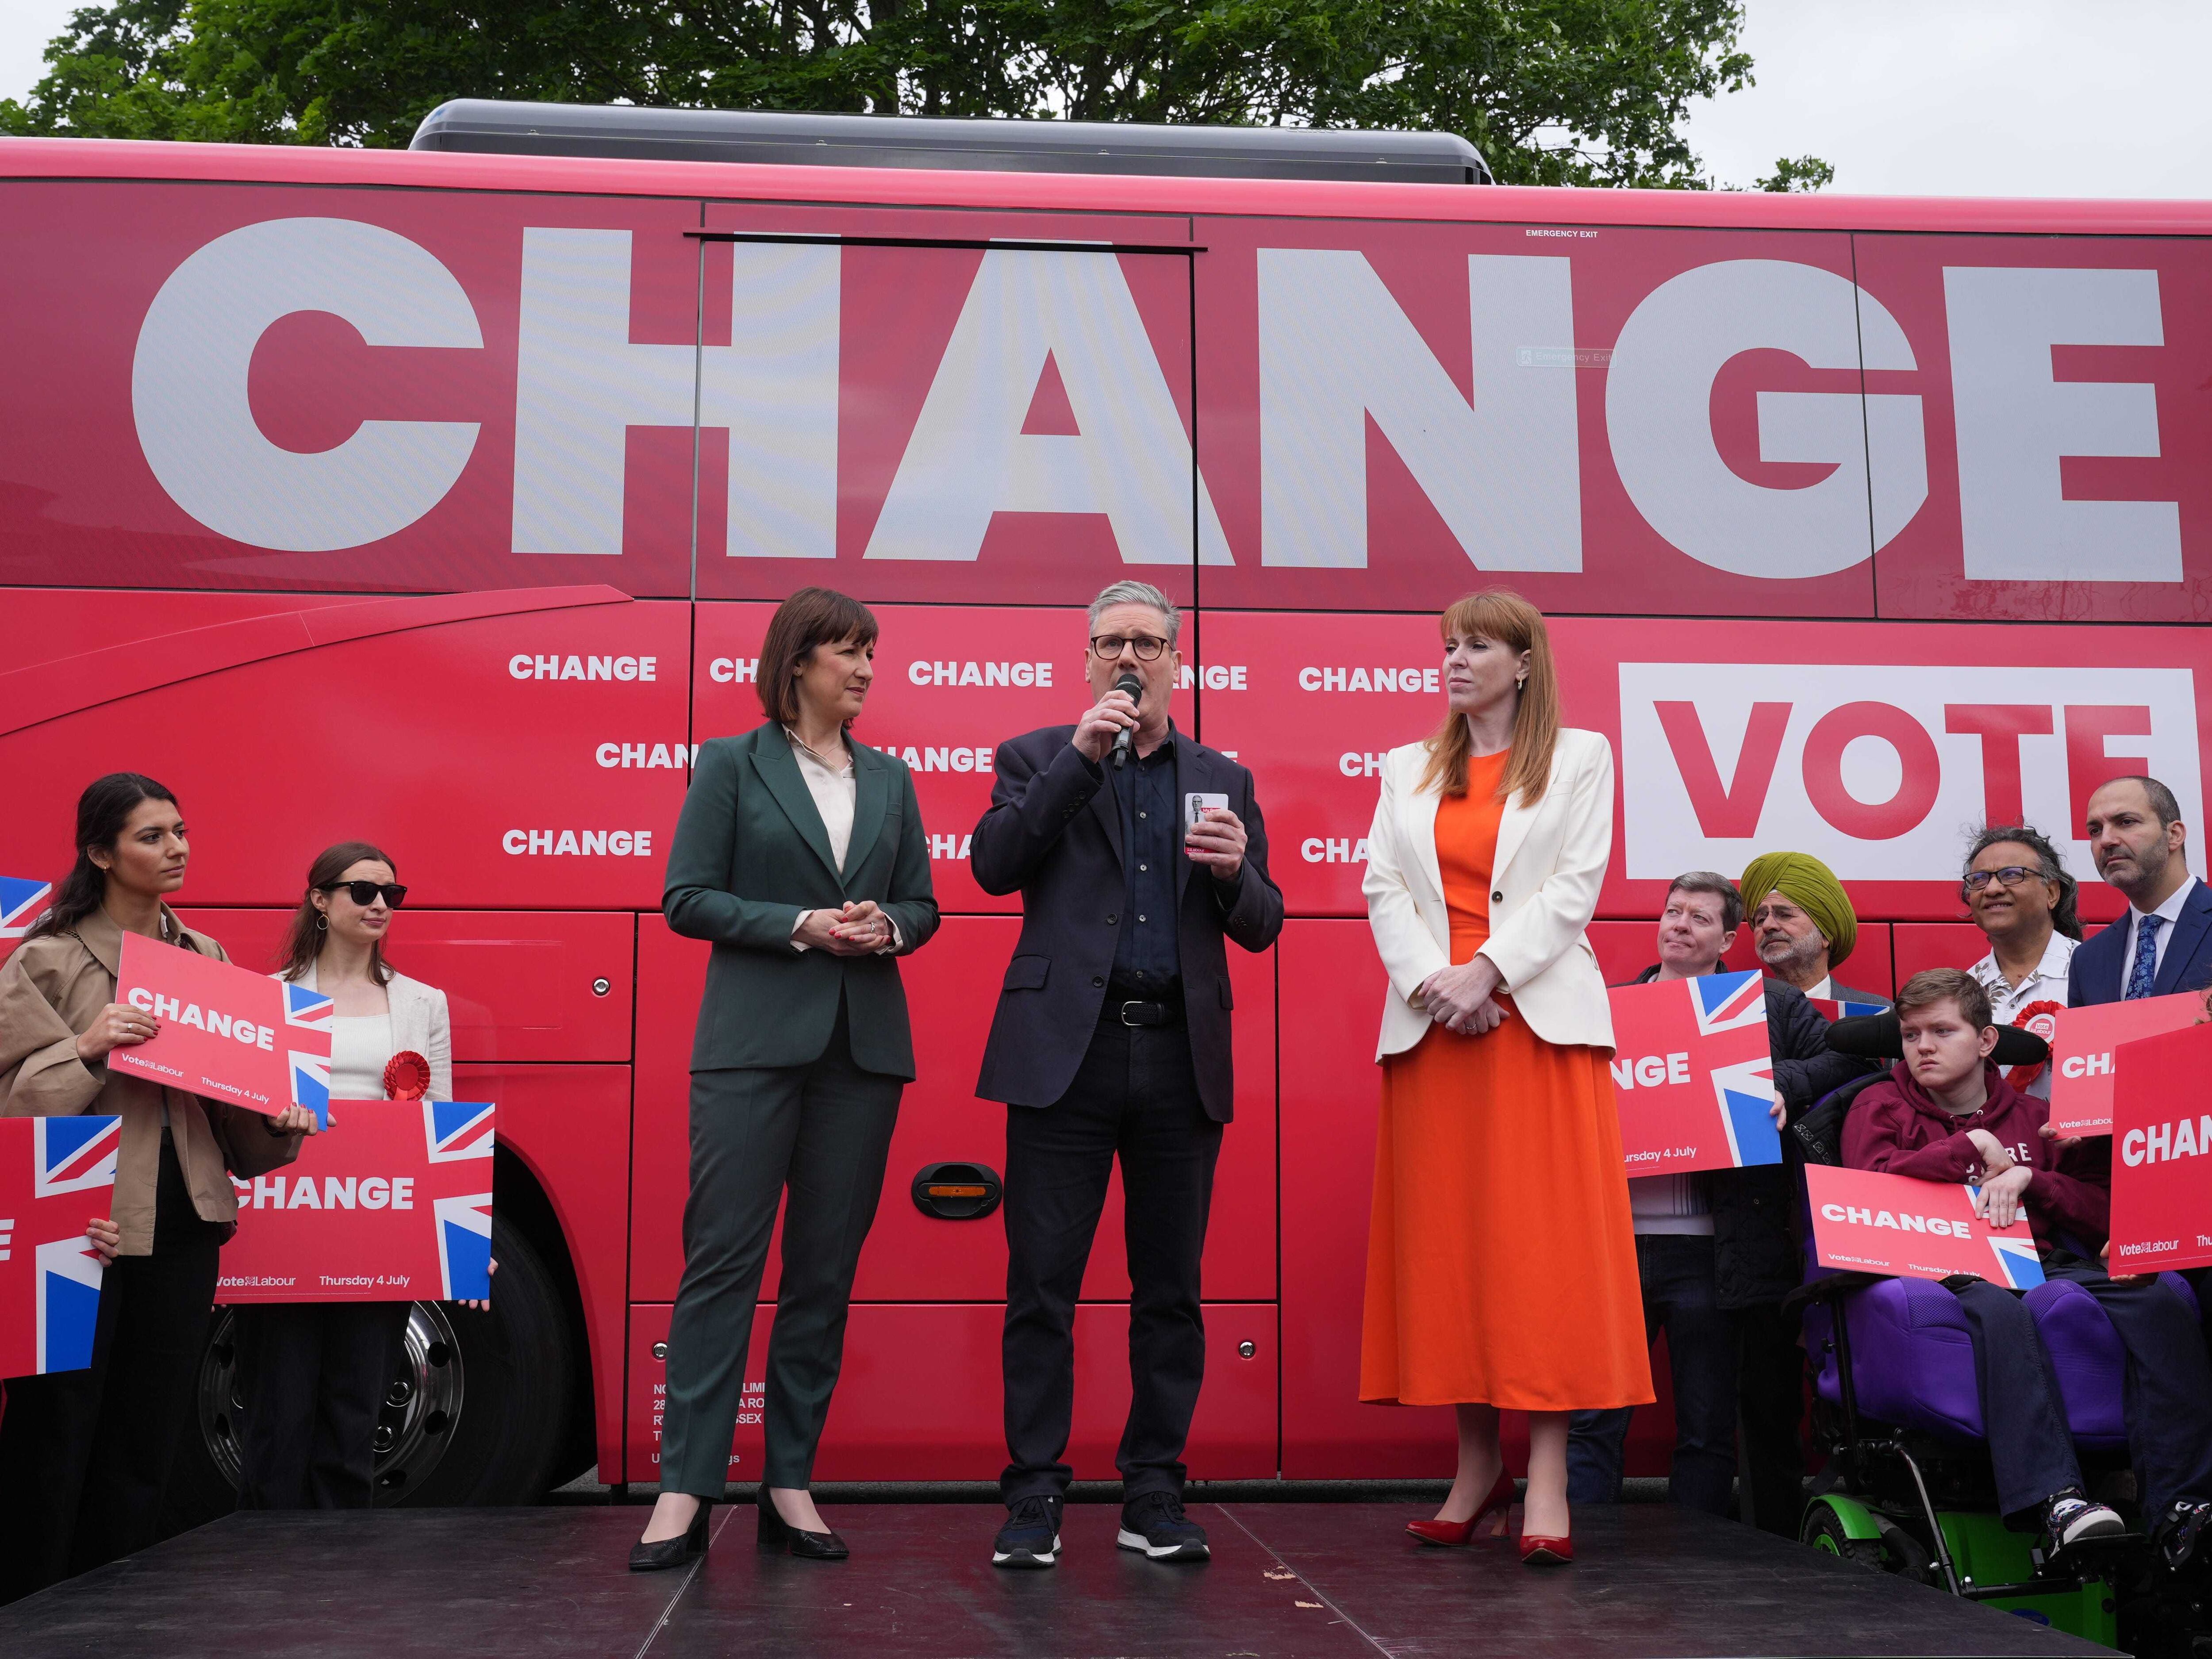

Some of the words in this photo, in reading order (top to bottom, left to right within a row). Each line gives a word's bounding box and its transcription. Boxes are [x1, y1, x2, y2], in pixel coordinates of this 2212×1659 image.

[1536, 353, 1589, 363] Emergency
[132, 217, 2183, 582] CHANGE
[509, 654, 657, 681] CHANGE
[908, 661, 1052, 687] CHANGE
[1173, 665, 1247, 690] NGE
[1299, 667, 1440, 693] CHANGE
[595, 743, 699, 768] CHAN
[873, 746, 993, 772] ANGE
[1653, 700, 2152, 840] VOTE
[503, 830, 652, 856] CHANGE
[1301, 838, 1368, 863] CHA
[128, 987, 274, 1051] CHANGE
[122, 1053, 145, 1066] Vote
[153, 1062, 184, 1077] Labour
[201, 1077, 242, 1097] Thursday
[252, 1092, 269, 1104] July
[1609, 1052, 1691, 1090] NGE
[2122, 1114, 2212, 1167] CHA
[1624, 1151, 1661, 1162] ursday
[1663, 1148, 1671, 1157] 4
[1673, 1146, 1697, 1158] July
[1821, 1204, 1972, 1239] CHANGE
[2120, 1244, 2142, 1256] Vote
[2149, 1240, 2179, 1253] Labour
[1828, 1253, 1851, 1262] Vote
[1859, 1257, 1890, 1267] Labour
[1908, 1264, 1951, 1275] Thursday
[217, 1276, 245, 1286] Vote
[255, 1276, 296, 1286] Labour
[319, 1275, 374, 1288] Thursday
[376, 1275, 384, 1285] 4
[386, 1275, 410, 1288] July
[743, 1382, 765, 1393] LIMI
[736, 1413, 762, 1424] SEX
